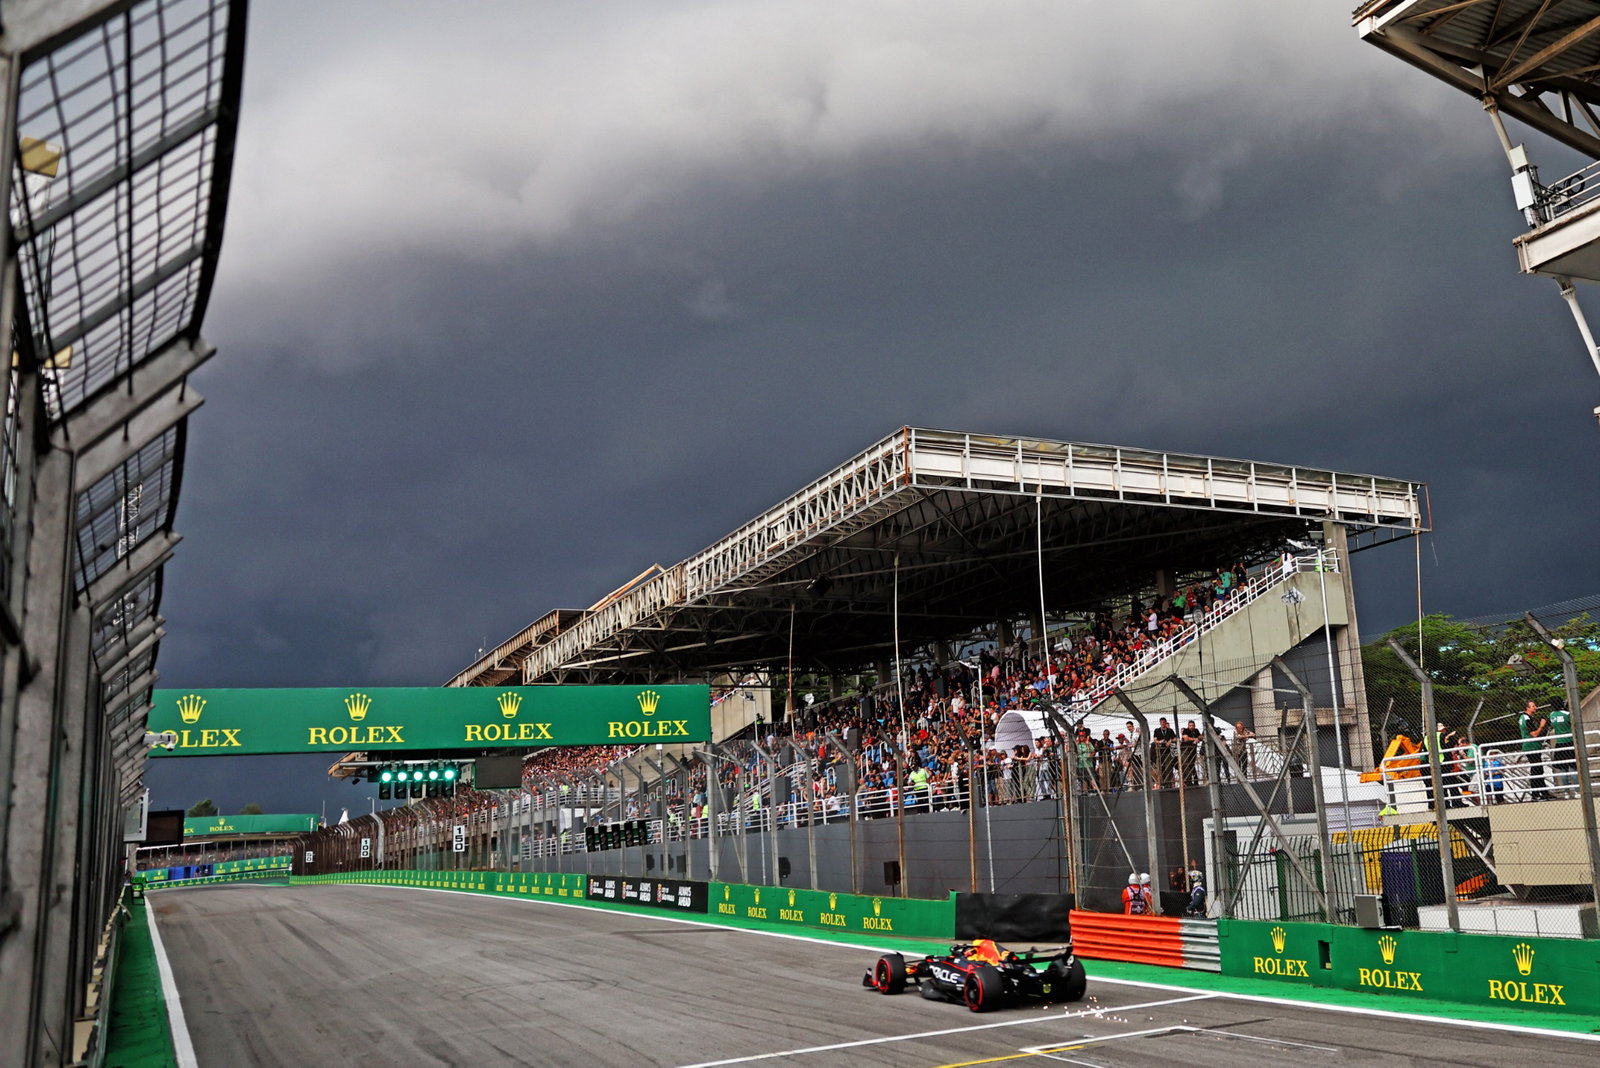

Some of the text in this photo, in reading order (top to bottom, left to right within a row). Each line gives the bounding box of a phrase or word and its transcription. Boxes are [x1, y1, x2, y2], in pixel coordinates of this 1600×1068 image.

[308, 726, 405, 744] ROLEX
[465, 723, 553, 741] ROLEX
[608, 720, 689, 737] ROLEX
[455, 828, 463, 850] 150
[719, 903, 736, 915] ROLEX
[748, 906, 767, 919] ROLEX
[780, 909, 803, 922] ROLEX
[820, 913, 846, 927] ROLEX
[863, 917, 893, 931] ROLEX
[1253, 957, 1310, 978] ROLEX
[1359, 968, 1424, 991] ROLEX
[1487, 980, 1567, 1006] ROLEX
